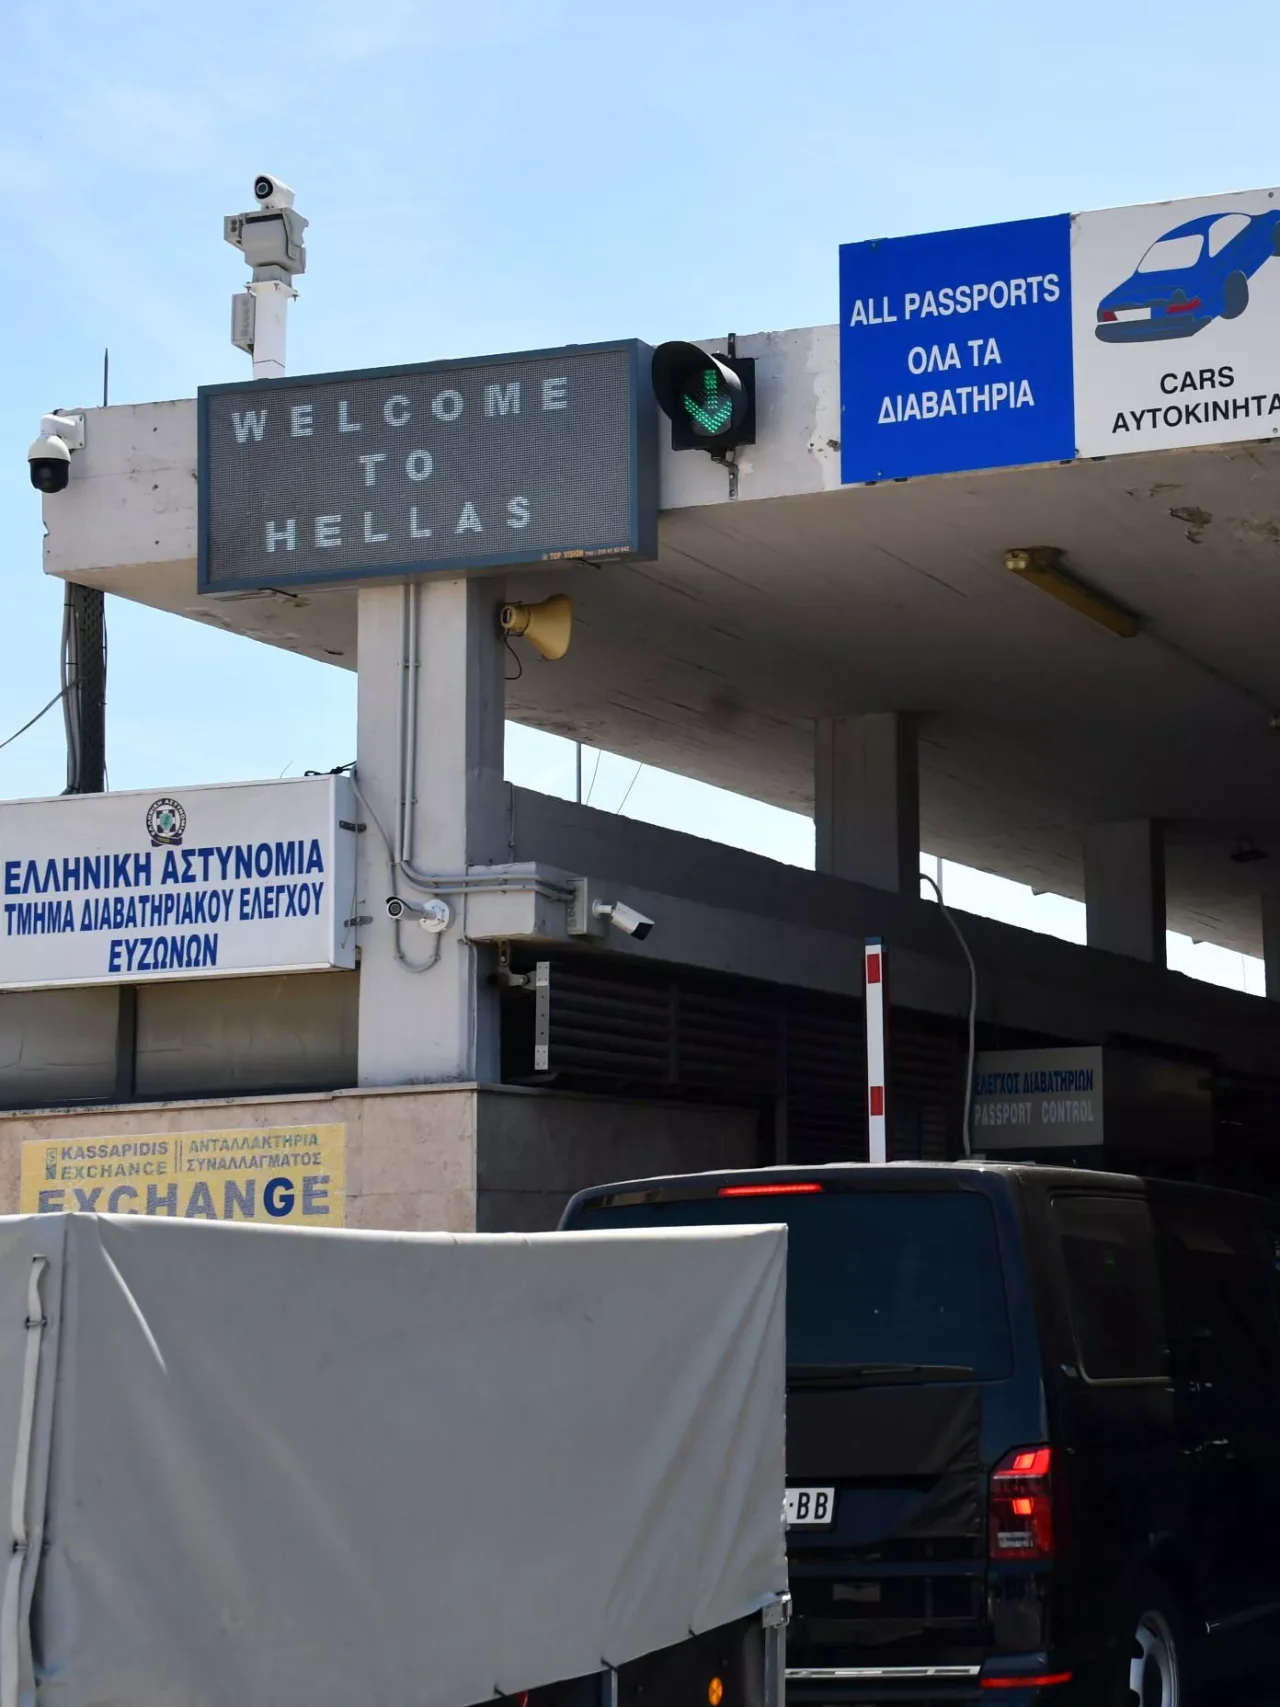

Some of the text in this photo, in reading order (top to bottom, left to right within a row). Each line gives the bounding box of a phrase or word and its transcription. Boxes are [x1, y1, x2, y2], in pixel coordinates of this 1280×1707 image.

[849, 273, 1060, 327] ALL PASSPORTS
[907, 338, 1002, 375] ΟΛΑ ΤΑ
[1159, 366, 1235, 395] CARS
[232, 377, 569, 443] WELCOME
[877, 379, 1035, 425] ΔΙΑΒΑΤΗΡΙΑ
[358, 449, 434, 486] TO
[265, 495, 532, 553] HELLAS
[4, 839, 324, 895] ΕΛΛΗΝΙΚΗ ΑΣΤΥΝΟΜΙΑ
[4, 882, 324, 936] ΤΜΗΜΑ ΔΙΑΒΑΤΗΡΙΑΚΟΥ ΕΛΕΓΧΟΥ
[108, 933, 218, 972] ΕΥΖΩΝΩΝ
[974, 1069, 1093, 1096] ΕΛΕΓΧΟΣ ΔΙΑΒΑΤΗΡΙΩΝ
[974, 1100, 1094, 1126] PASSPORT CONTROL
[61, 1141, 169, 1161] KASSAPIDIS
[188, 1132, 318, 1154] ΑΝΤΑΛΛΑΚΤΗΡΙΑ
[61, 1161, 167, 1180] EXCHANGE
[186, 1151, 321, 1173] ΣΥΝΑΛΛΑΓΜΑΤΟΣ
[37, 1175, 330, 1219] EXCHANGE
